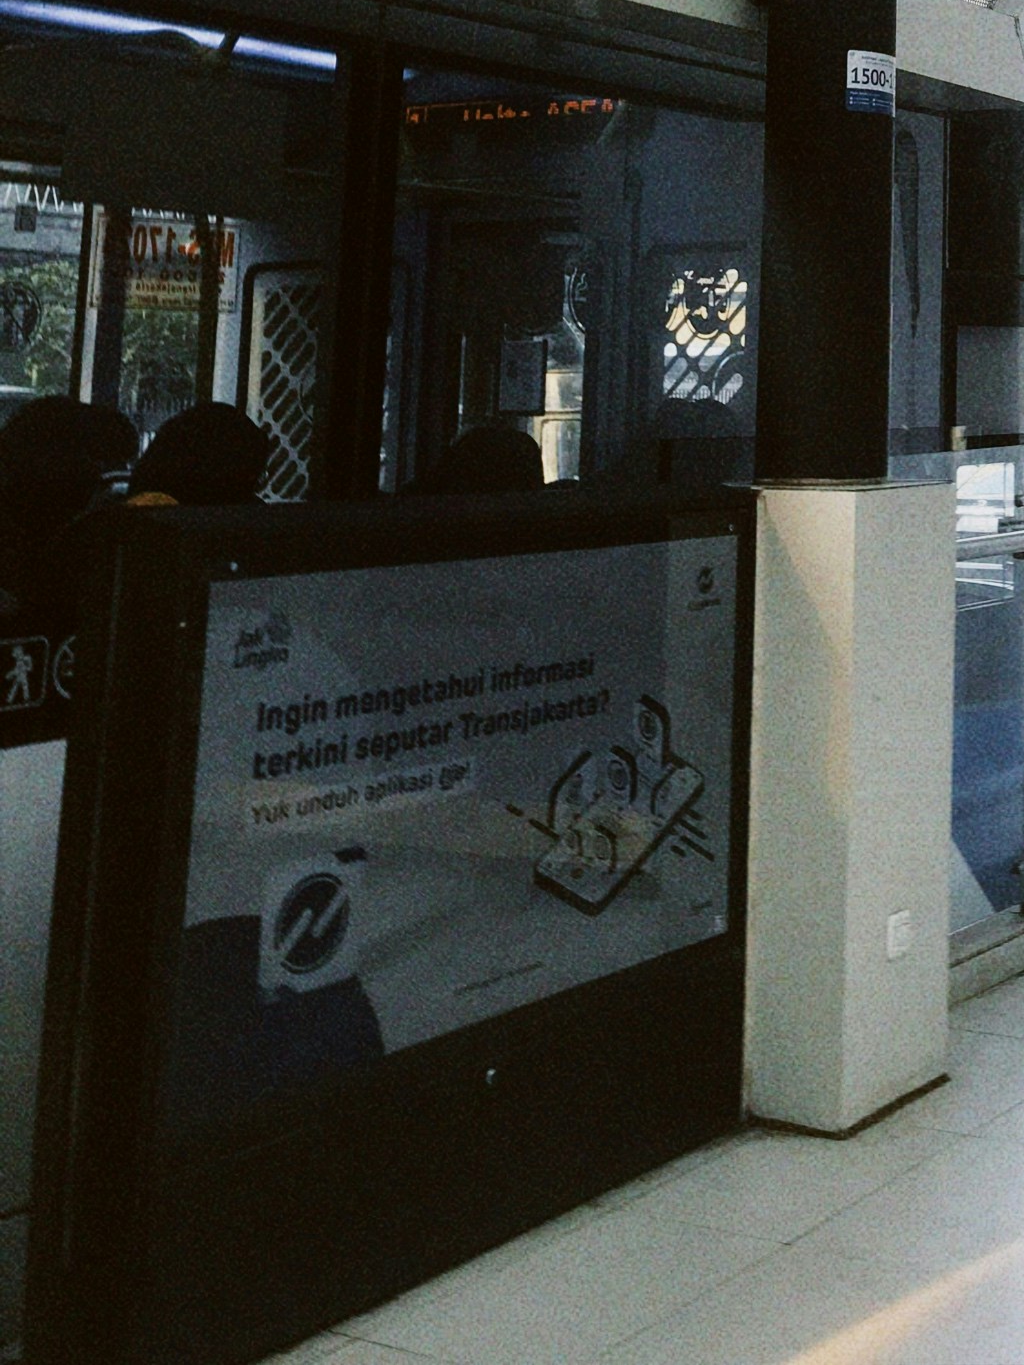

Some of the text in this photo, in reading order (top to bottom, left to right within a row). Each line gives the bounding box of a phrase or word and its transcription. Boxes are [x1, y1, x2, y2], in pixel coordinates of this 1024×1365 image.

[257, 652, 596, 733] Ingin mengetahui informasi
[252, 690, 612, 780] terkini seputar Transjakarta?
[252, 800, 292, 826] Yuk
[296, 787, 360, 819] unduh
[365, 767, 434, 804] aplikasi
